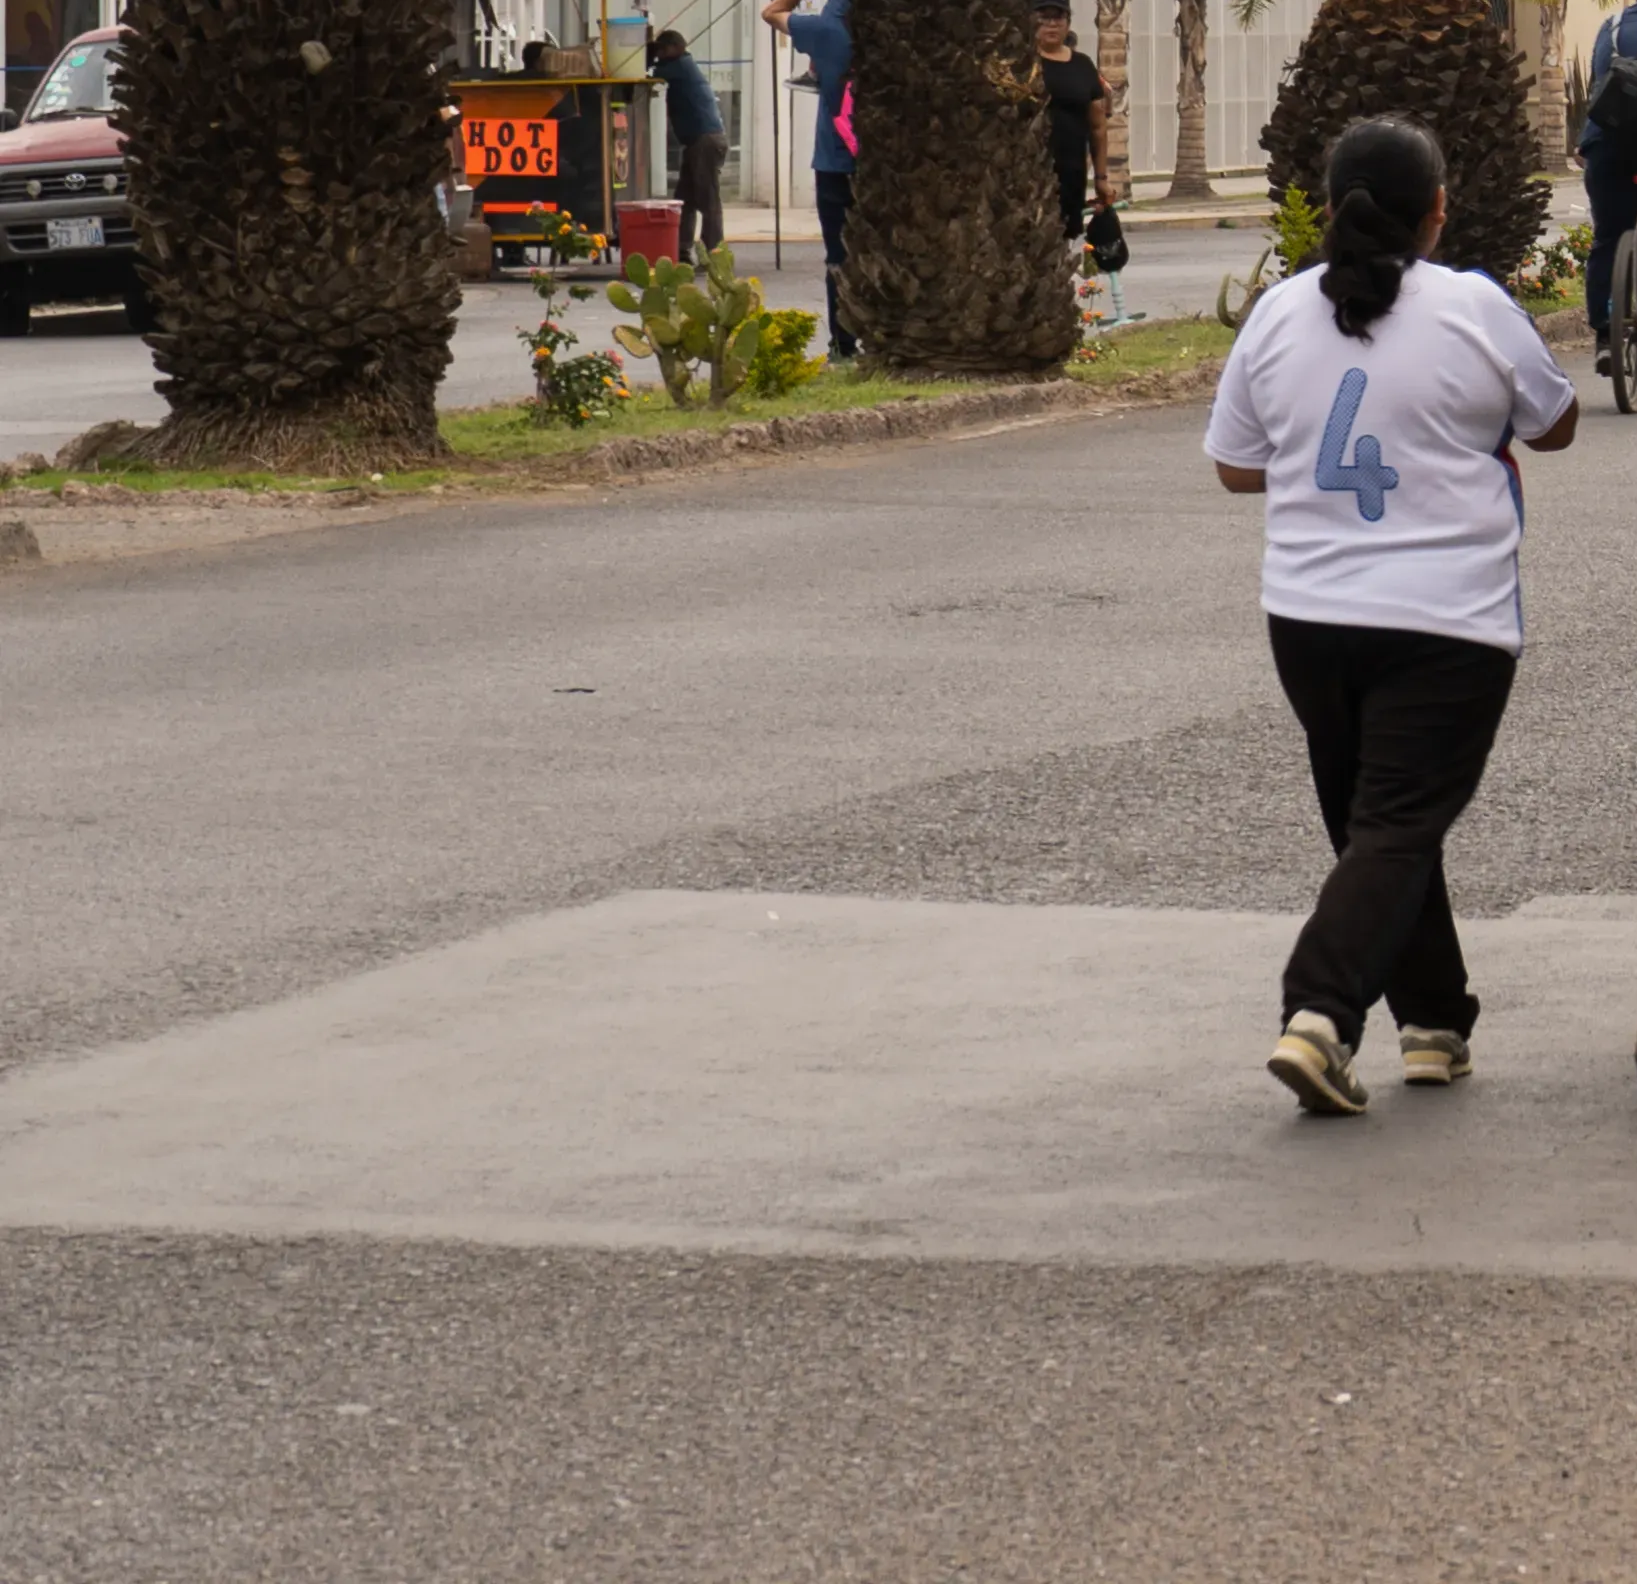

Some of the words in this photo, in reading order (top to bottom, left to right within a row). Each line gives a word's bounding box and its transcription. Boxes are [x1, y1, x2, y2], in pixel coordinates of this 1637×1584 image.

[468, 121, 545, 148] HOT
[484, 147, 553, 173] DOG
[1315, 367, 1399, 522] 4
